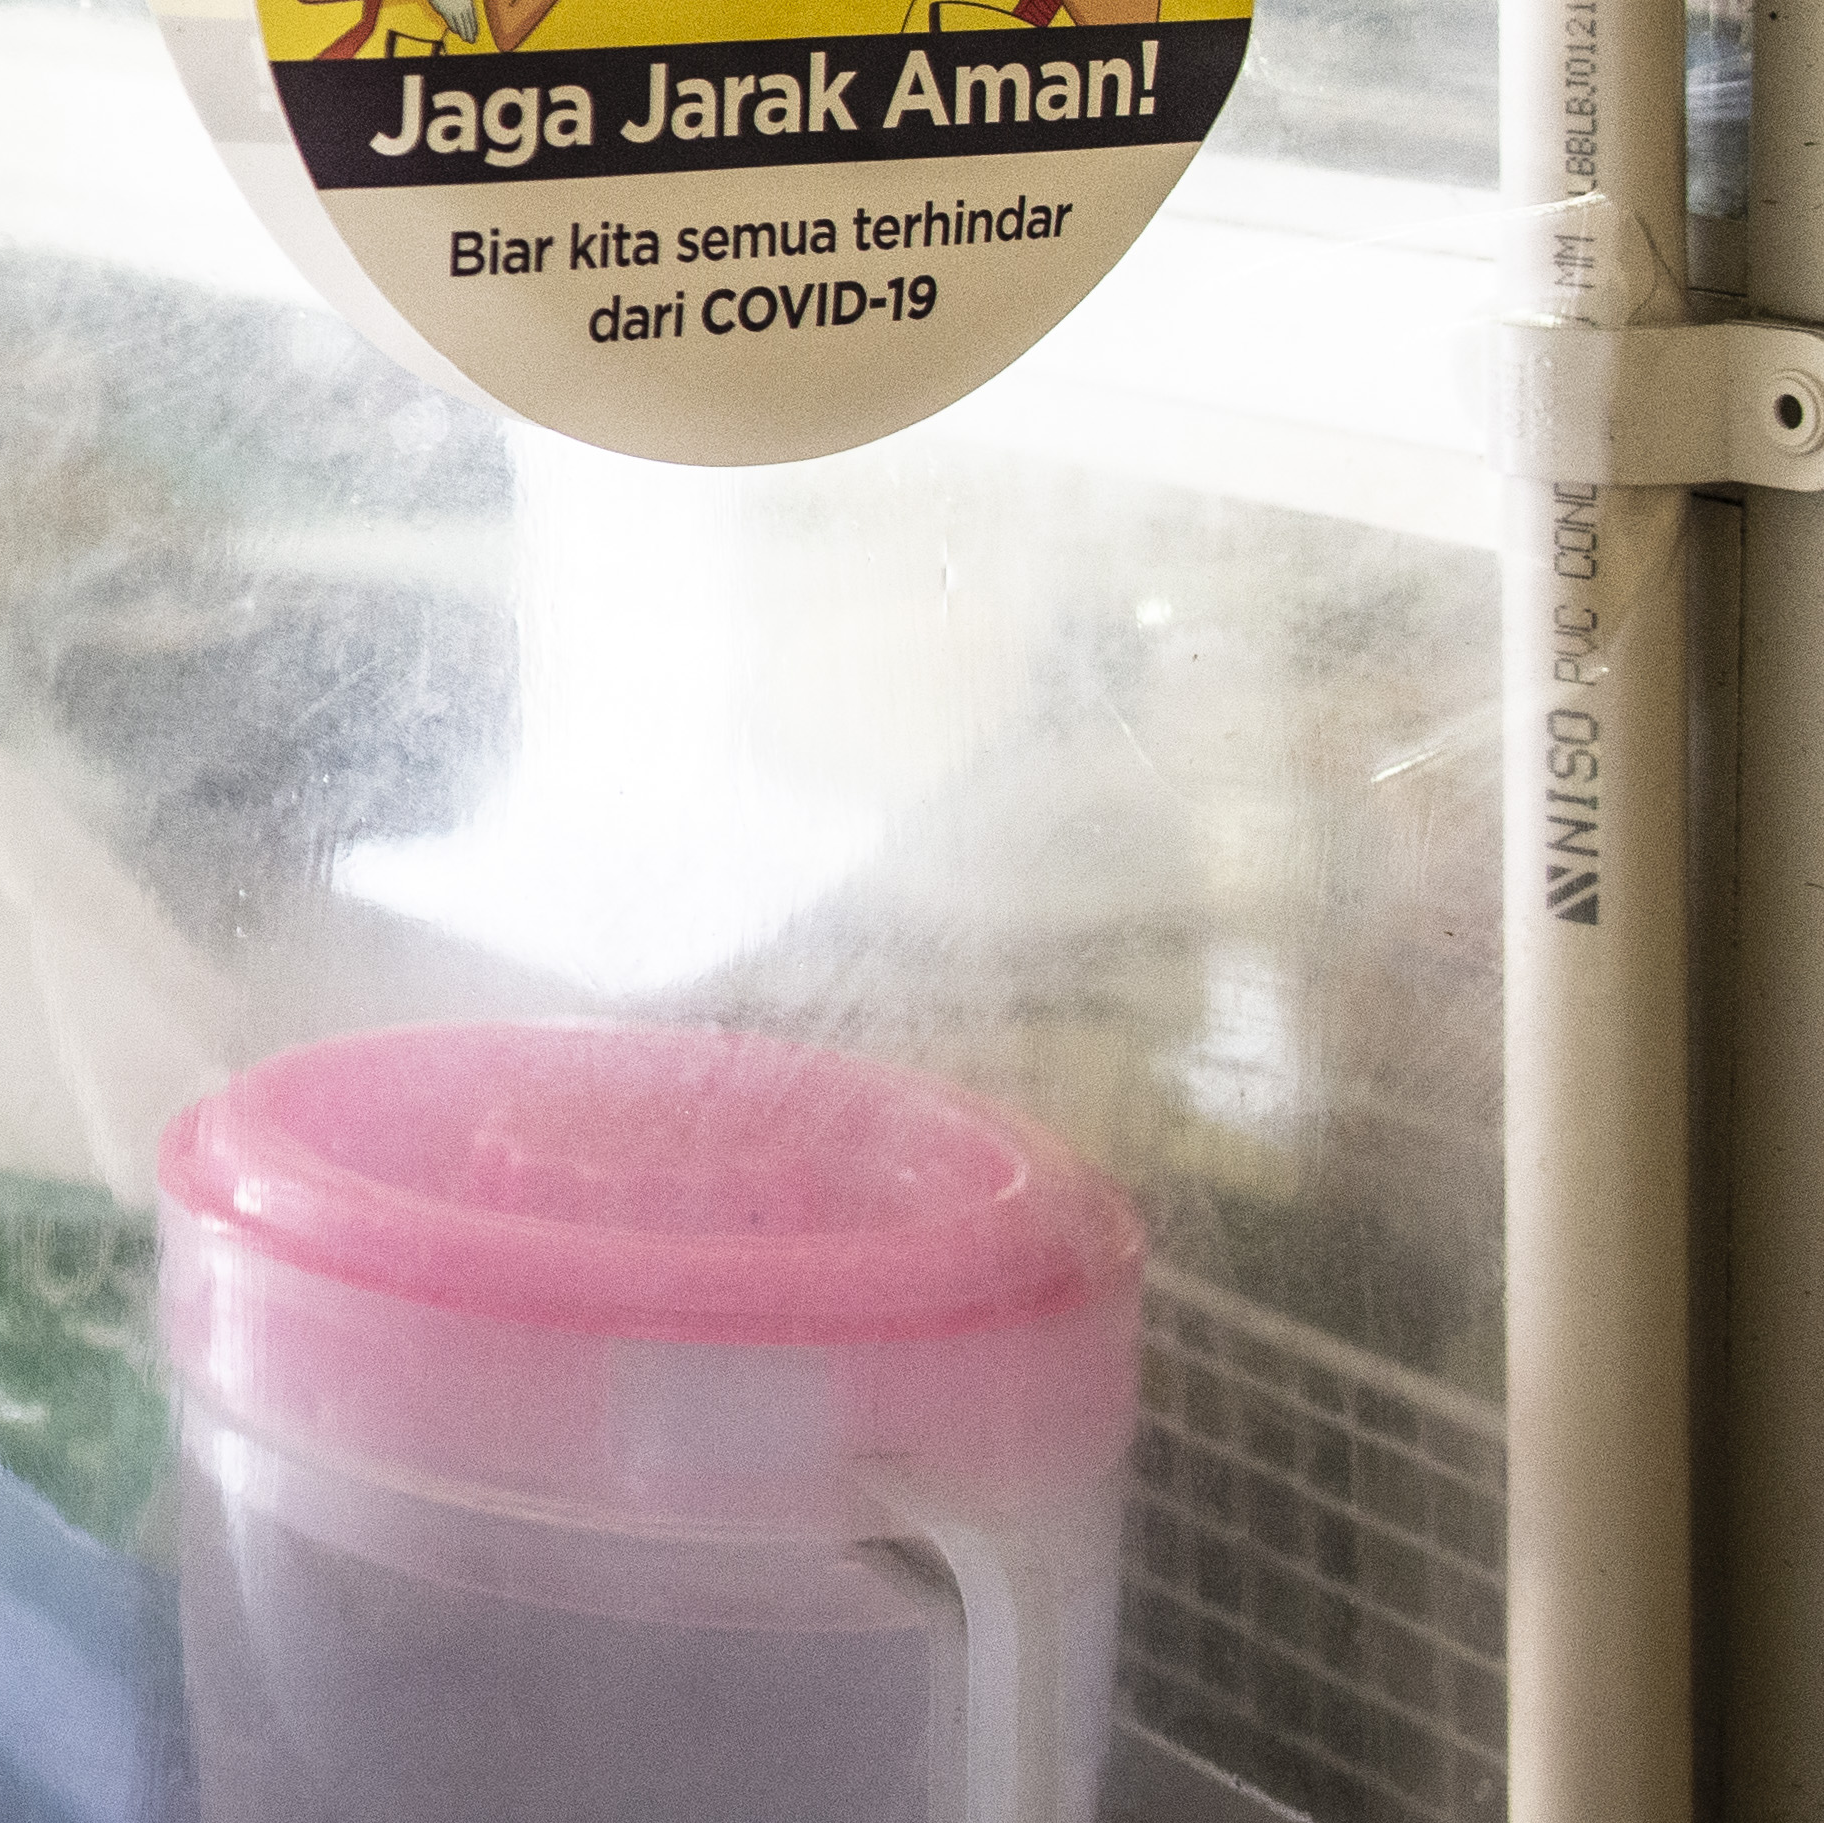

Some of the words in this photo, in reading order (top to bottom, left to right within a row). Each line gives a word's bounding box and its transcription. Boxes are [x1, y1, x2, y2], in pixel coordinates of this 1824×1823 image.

[368, 73, 594, 168] Jaga
[619, 51, 858, 144] Jarak
[882, 40, 1159, 130] Aman!
[449, 228, 554, 278] Biar
[568, 222, 660, 271] kita
[676, 212, 837, 264] semua
[853, 195, 1073, 251] terhindar
[1552, 234, 1596, 290] MM
[588, 296, 685, 343] dari
[701, 273, 939, 336] COVID-19
[1553, 604, 1599, 686] PVC
[1544, 710, 1599, 858] NISO
